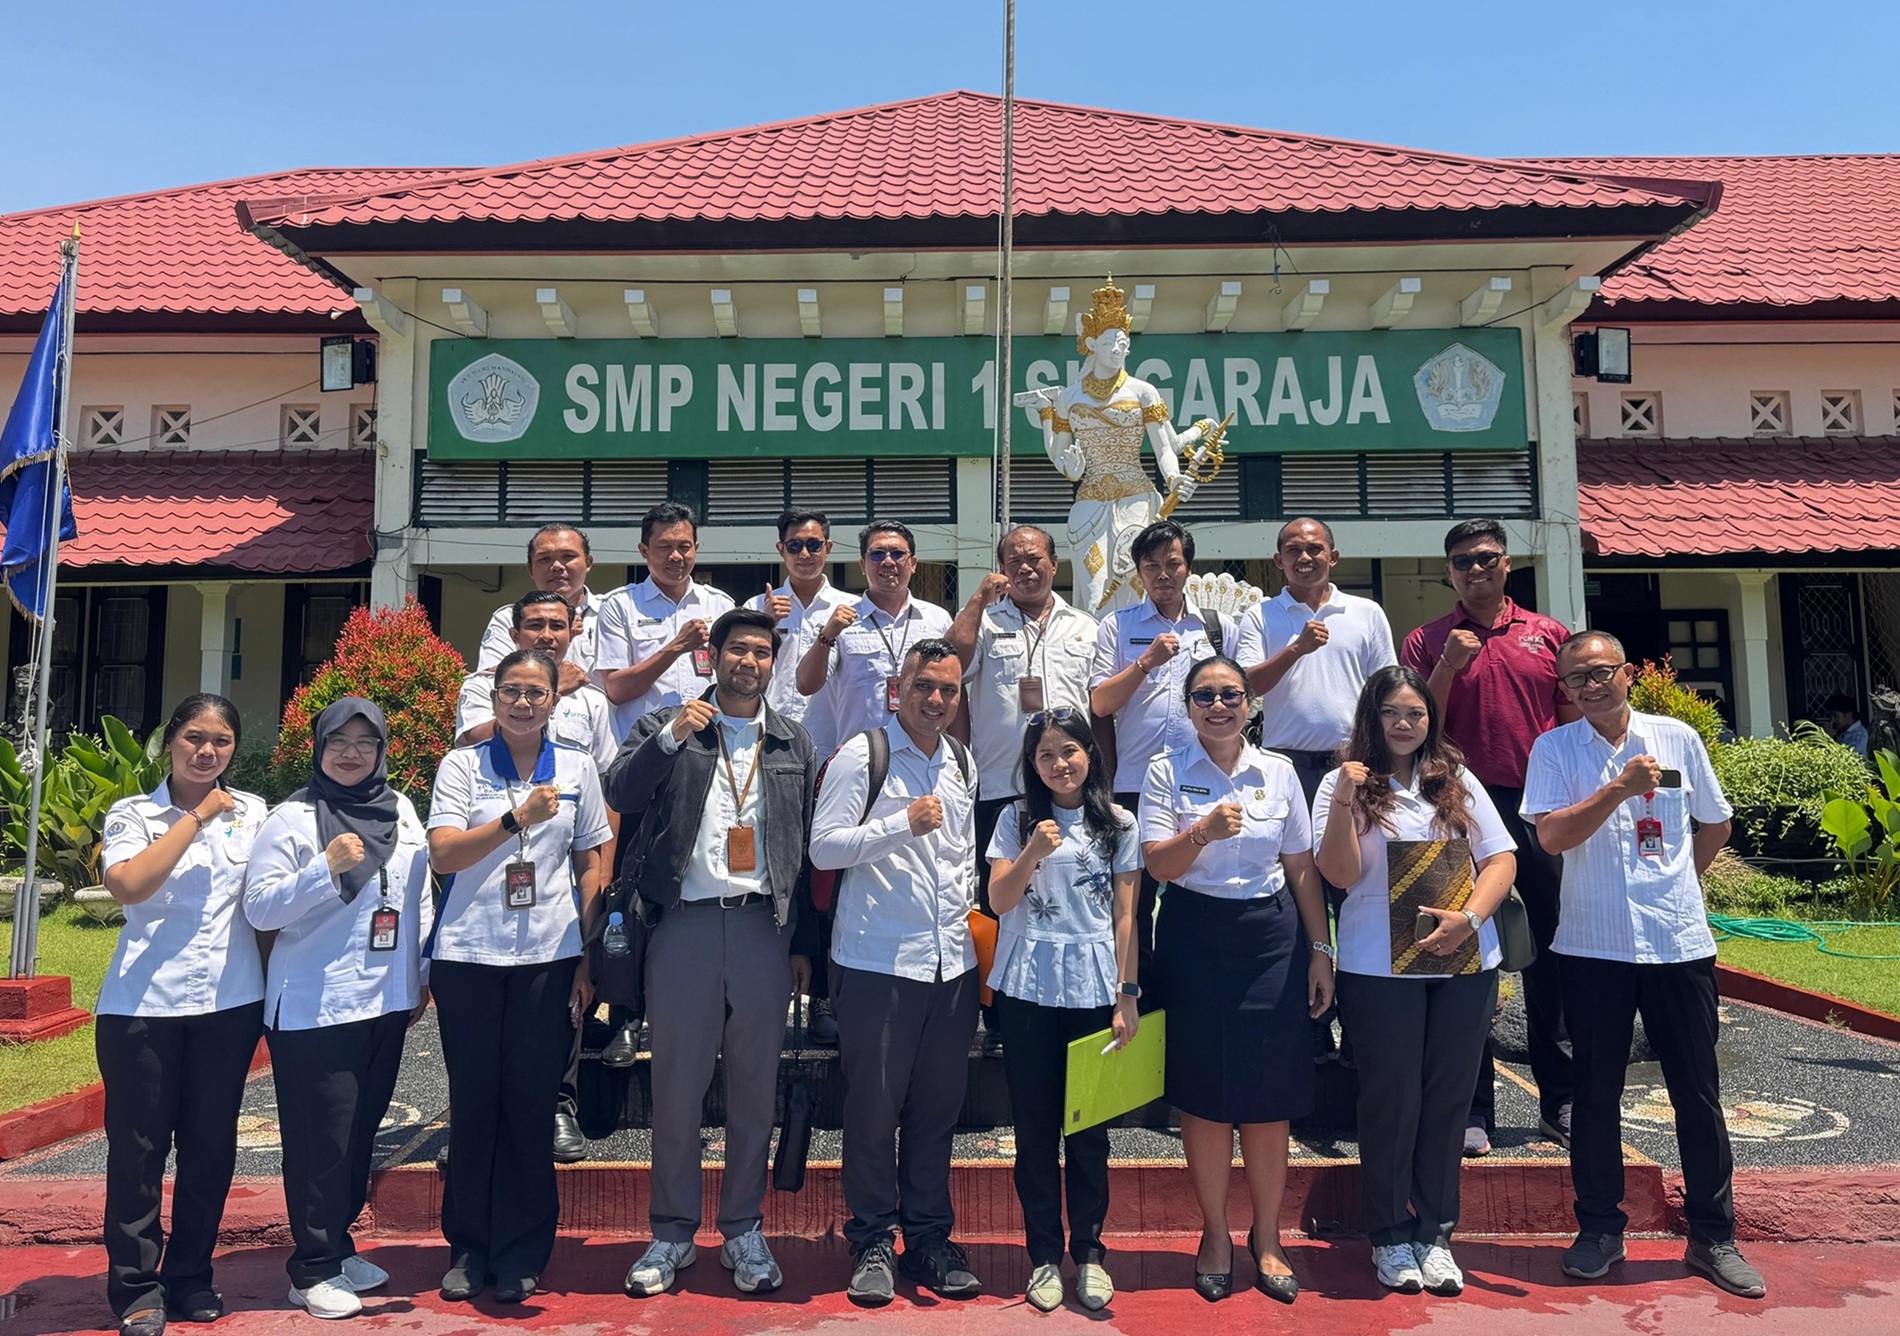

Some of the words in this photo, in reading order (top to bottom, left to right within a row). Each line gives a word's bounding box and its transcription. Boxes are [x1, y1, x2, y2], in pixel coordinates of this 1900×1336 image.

[563, 363, 694, 433] SMP
[716, 361, 945, 432] NEGERI
[971, 360, 995, 430] 1
[1025, 355, 1391, 430] SGARAJA
